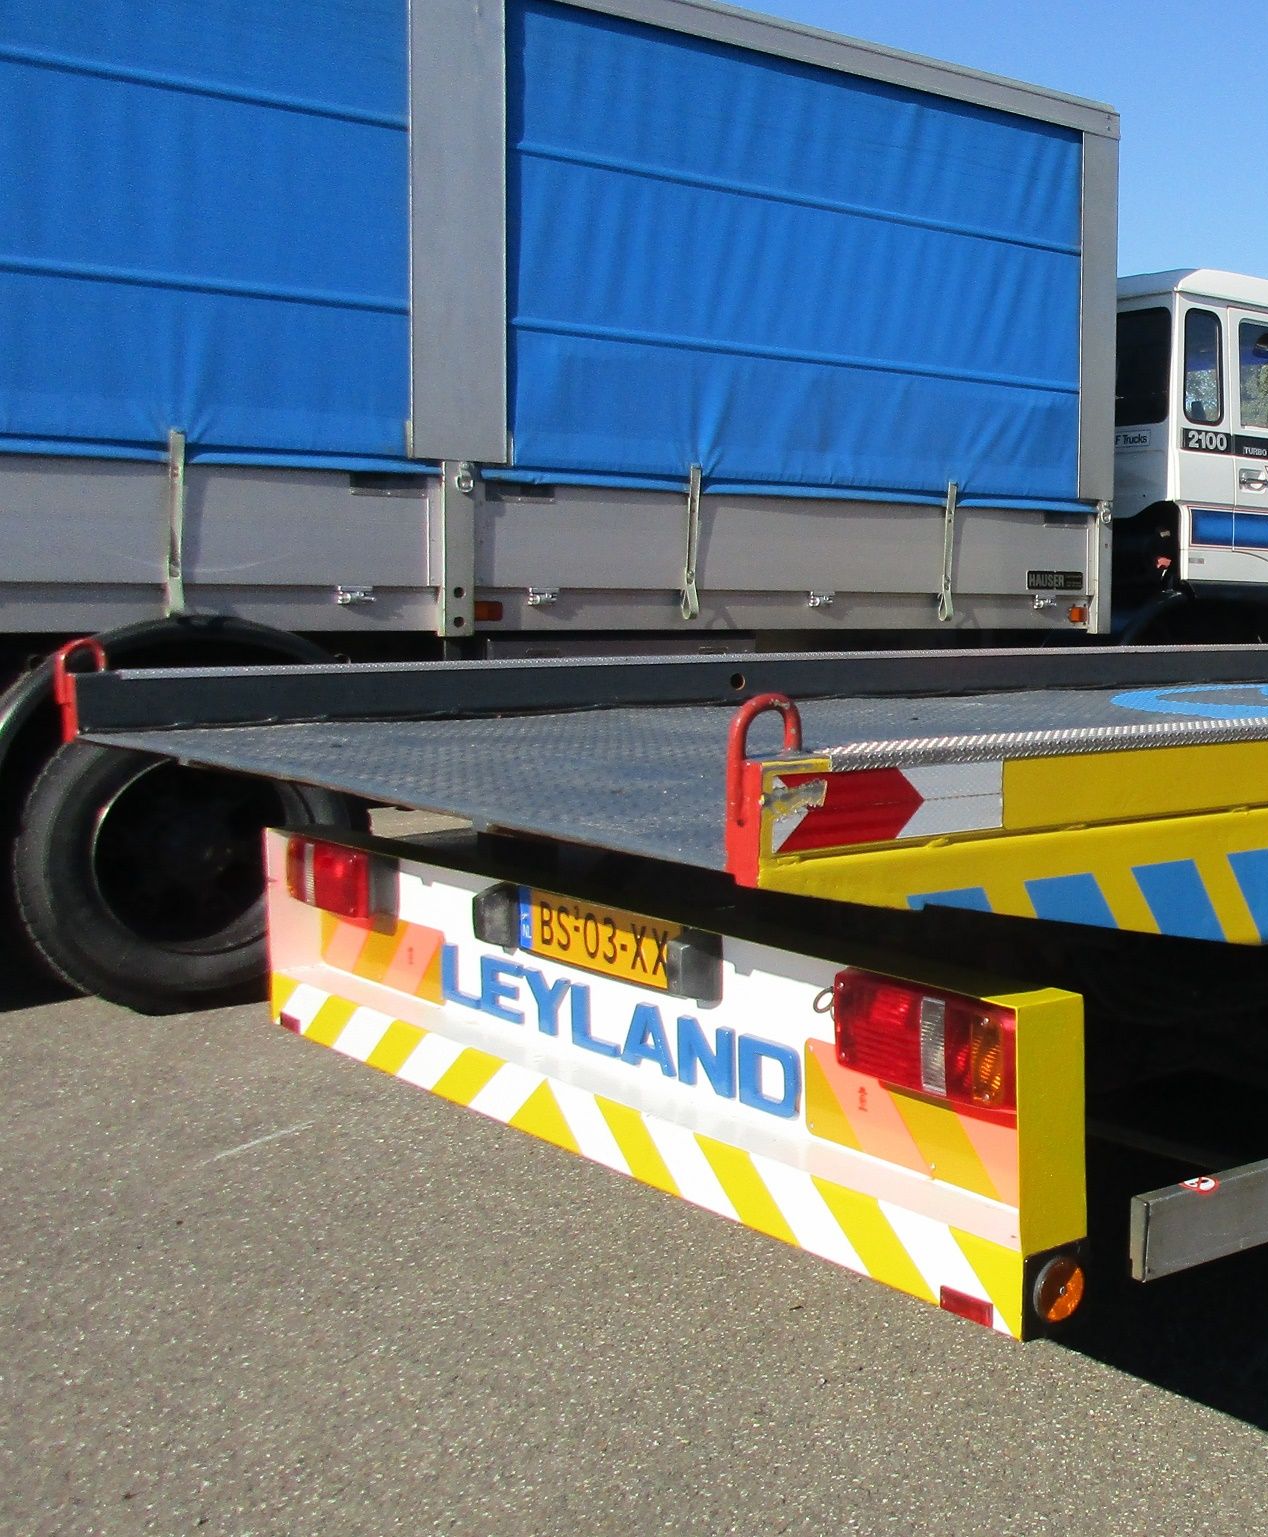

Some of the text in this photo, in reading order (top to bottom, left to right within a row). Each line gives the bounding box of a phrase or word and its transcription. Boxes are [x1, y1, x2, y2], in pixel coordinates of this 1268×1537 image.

[1123, 434, 1147, 445] Trucks
[1188, 430, 1228, 450] 2100
[1244, 446, 1268, 457] TURBO
[1029, 573, 1065, 588] HAUSER
[441, 943, 802, 1121] LEYLAND
